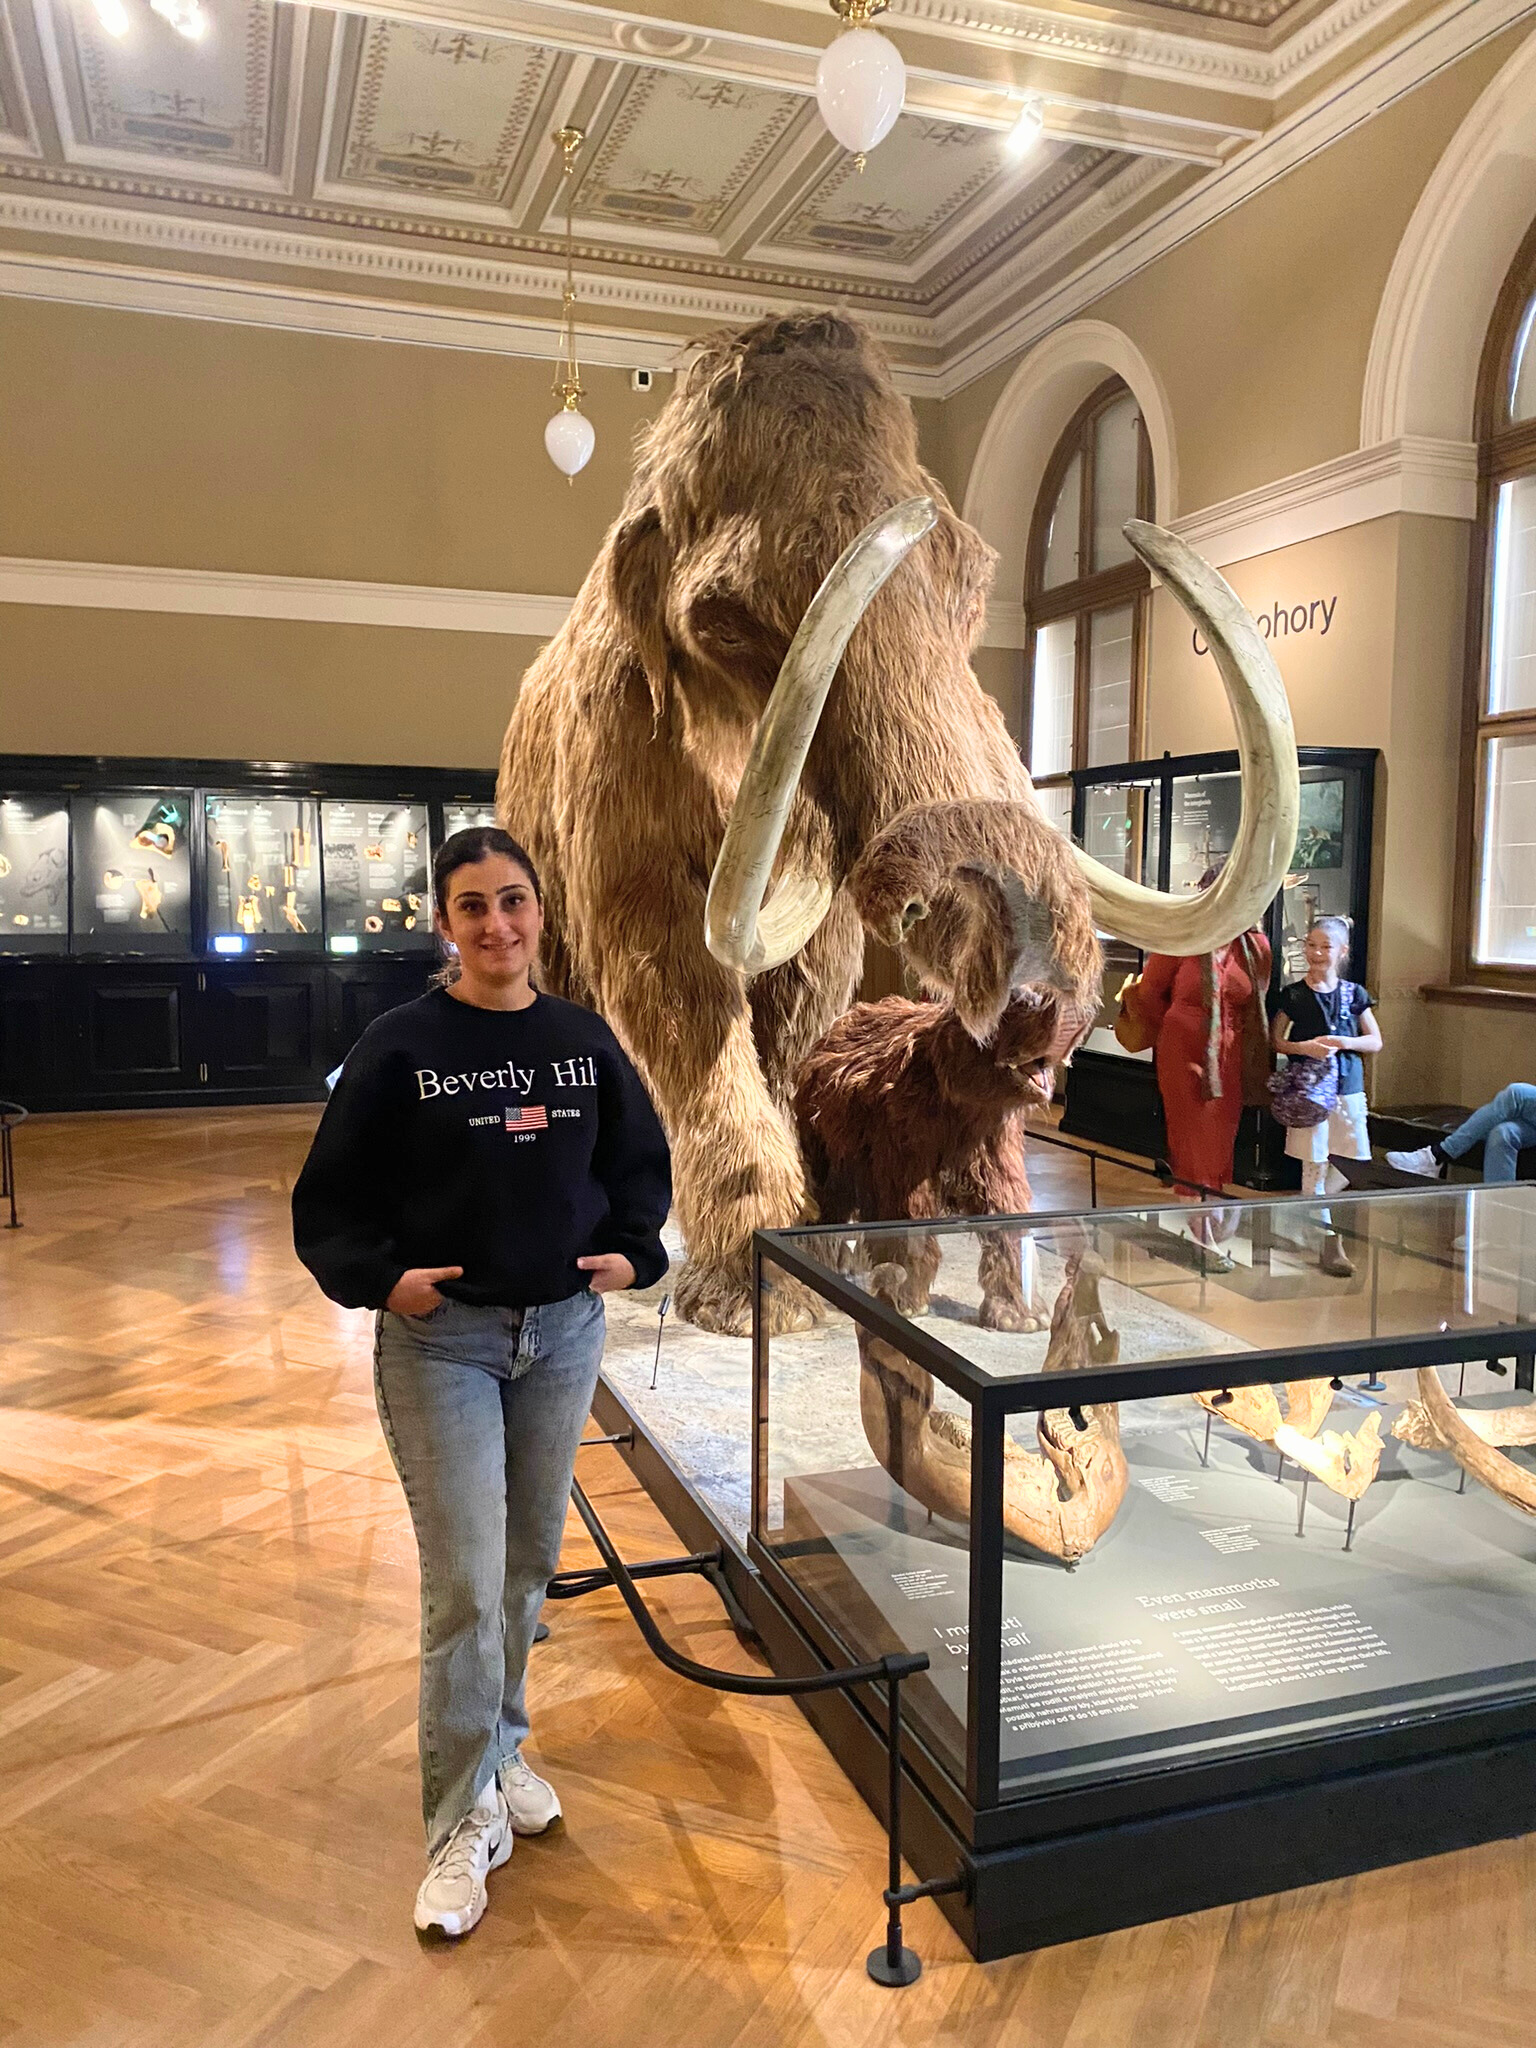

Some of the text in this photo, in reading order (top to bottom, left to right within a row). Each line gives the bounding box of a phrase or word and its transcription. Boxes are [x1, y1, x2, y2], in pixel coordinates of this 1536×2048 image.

[414, 1060, 536, 1100] Beverly
[469, 1110, 581, 1126] UNITED STATES
[514, 1134, 536, 1143] 1999
[1135, 1578, 1280, 1608] Even mammoths
[1152, 1598, 1246, 1622] were small
[946, 1616, 1023, 1637] mauti
